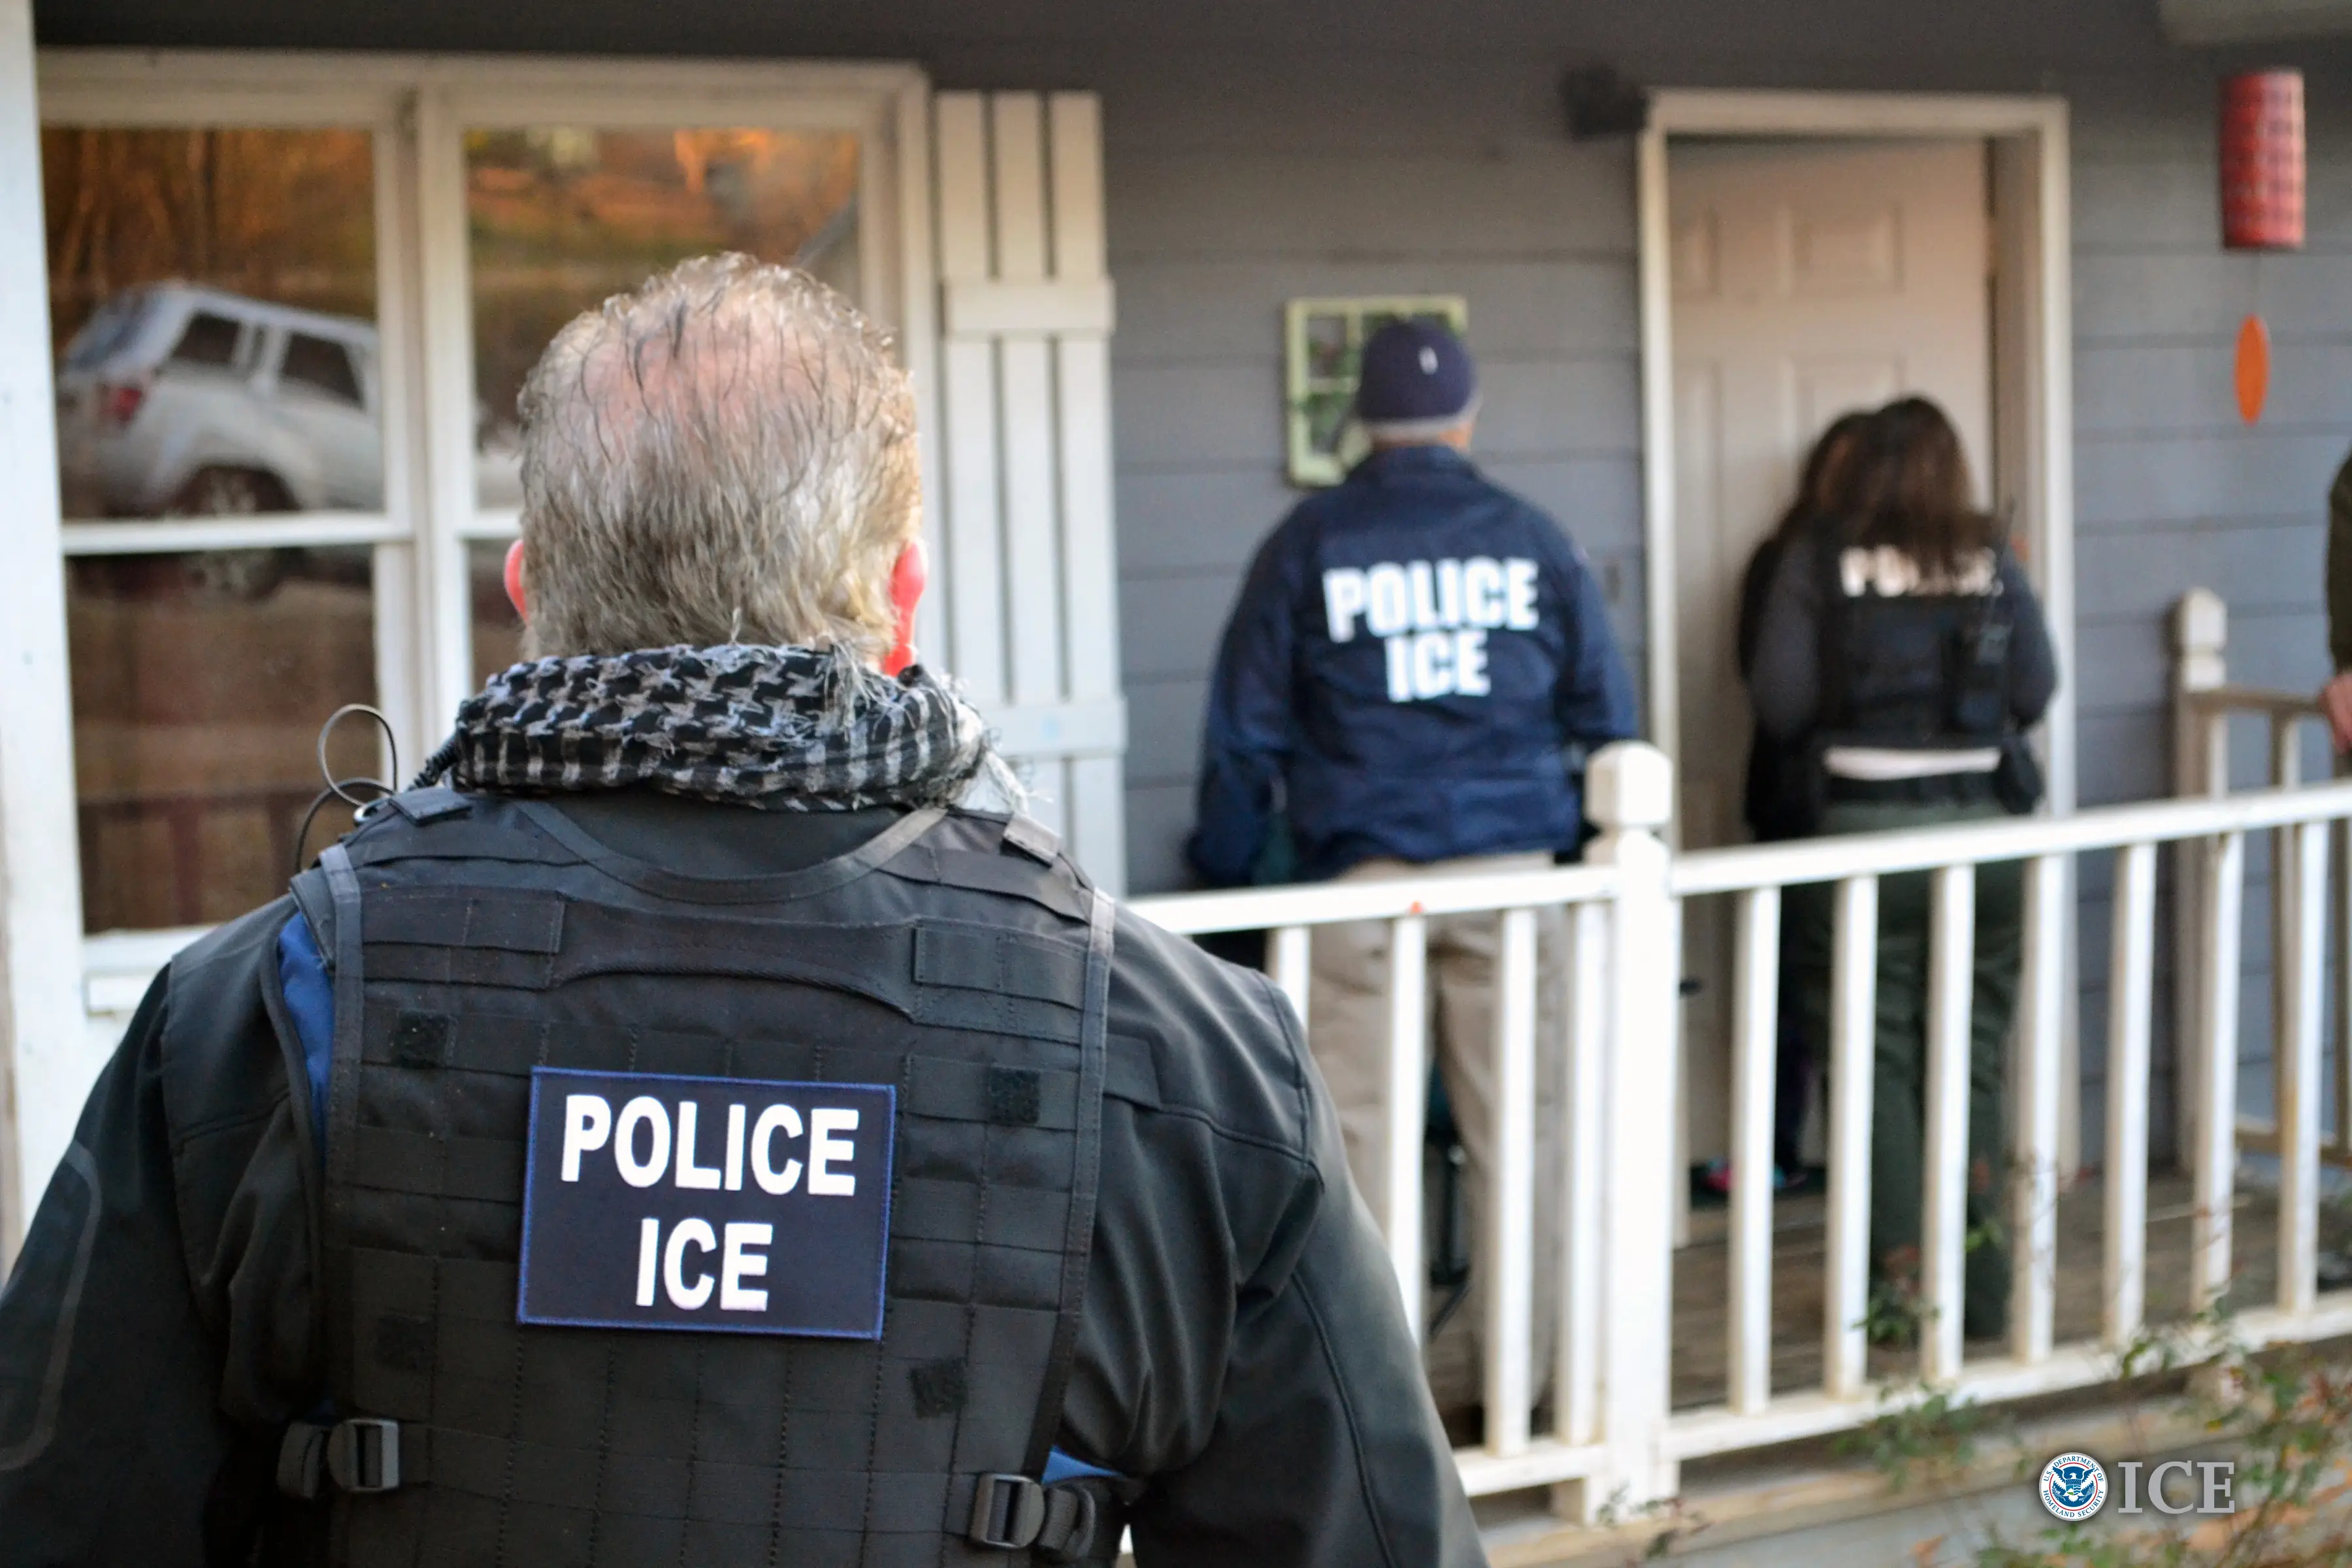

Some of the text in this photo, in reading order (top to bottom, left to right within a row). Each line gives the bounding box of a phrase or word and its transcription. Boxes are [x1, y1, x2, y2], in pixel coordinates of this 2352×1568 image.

[1323, 557, 1539, 642] POLICE
[1386, 630, 1491, 702] ICE
[561, 1094, 858, 1196] POLICE
[636, 1218, 773, 1311] ICE
